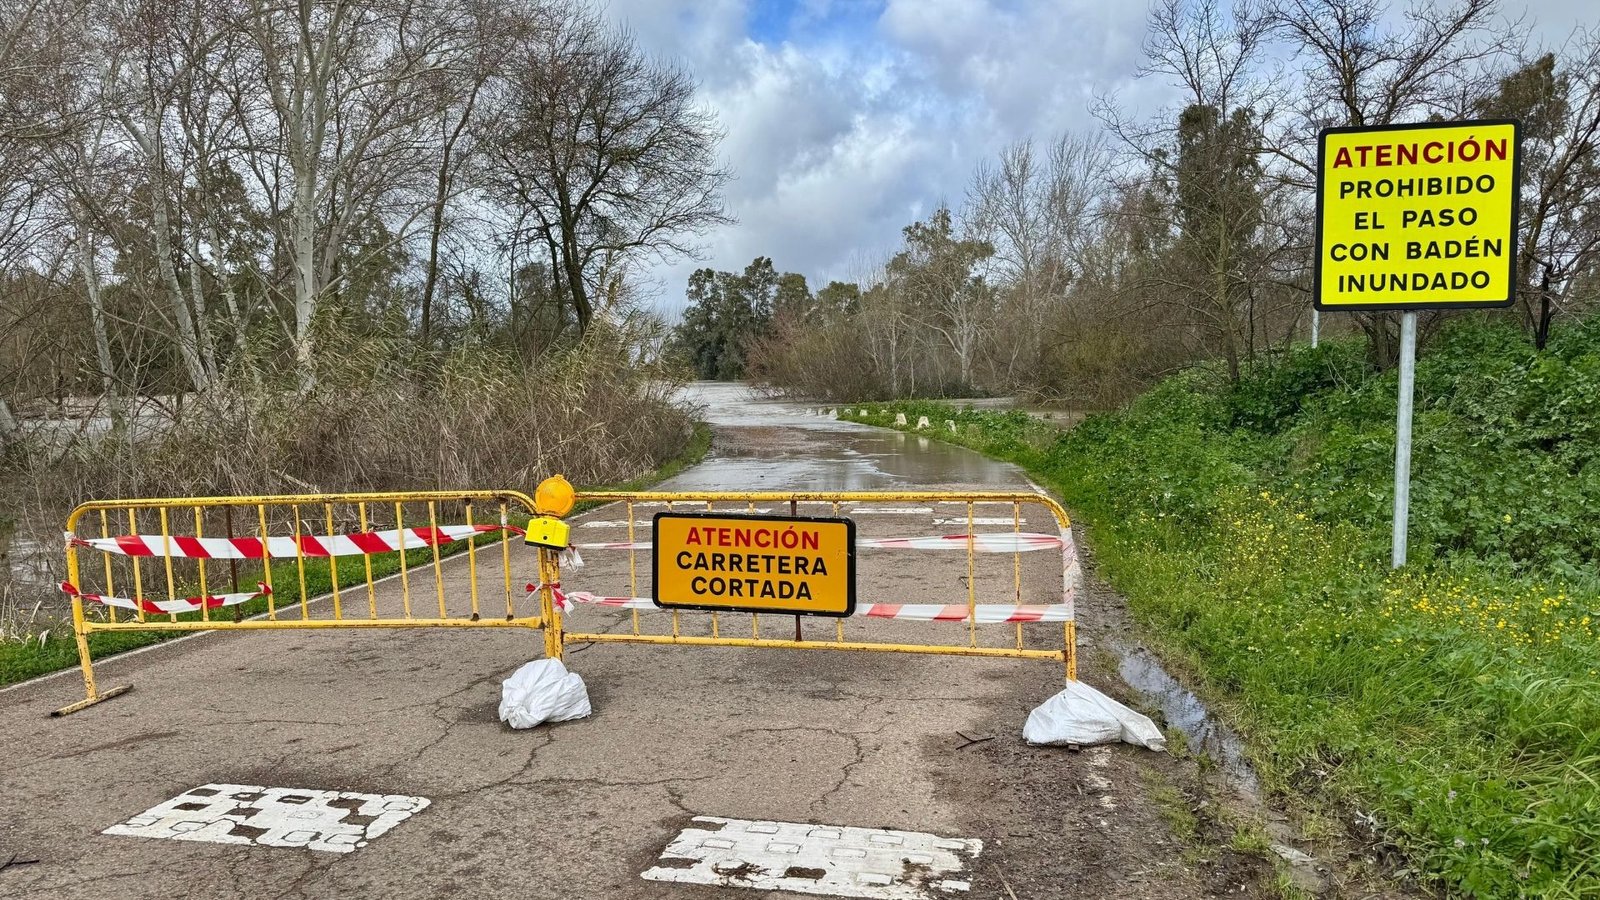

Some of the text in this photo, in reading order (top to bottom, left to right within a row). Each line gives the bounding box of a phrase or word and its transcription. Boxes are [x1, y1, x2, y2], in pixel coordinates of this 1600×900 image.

[1333, 135, 1507, 168] ATENCIÓN
[1340, 174, 1495, 199] PROHIBIDO
[1354, 207, 1477, 230] EL PASO
[1330, 236, 1502, 262] CON BADÉN
[1338, 271, 1490, 293] INUNDADO
[686, 526, 819, 550] ATENCIÓN
[676, 551, 828, 576] CARRETERA
[691, 576, 812, 600] CORTADA
